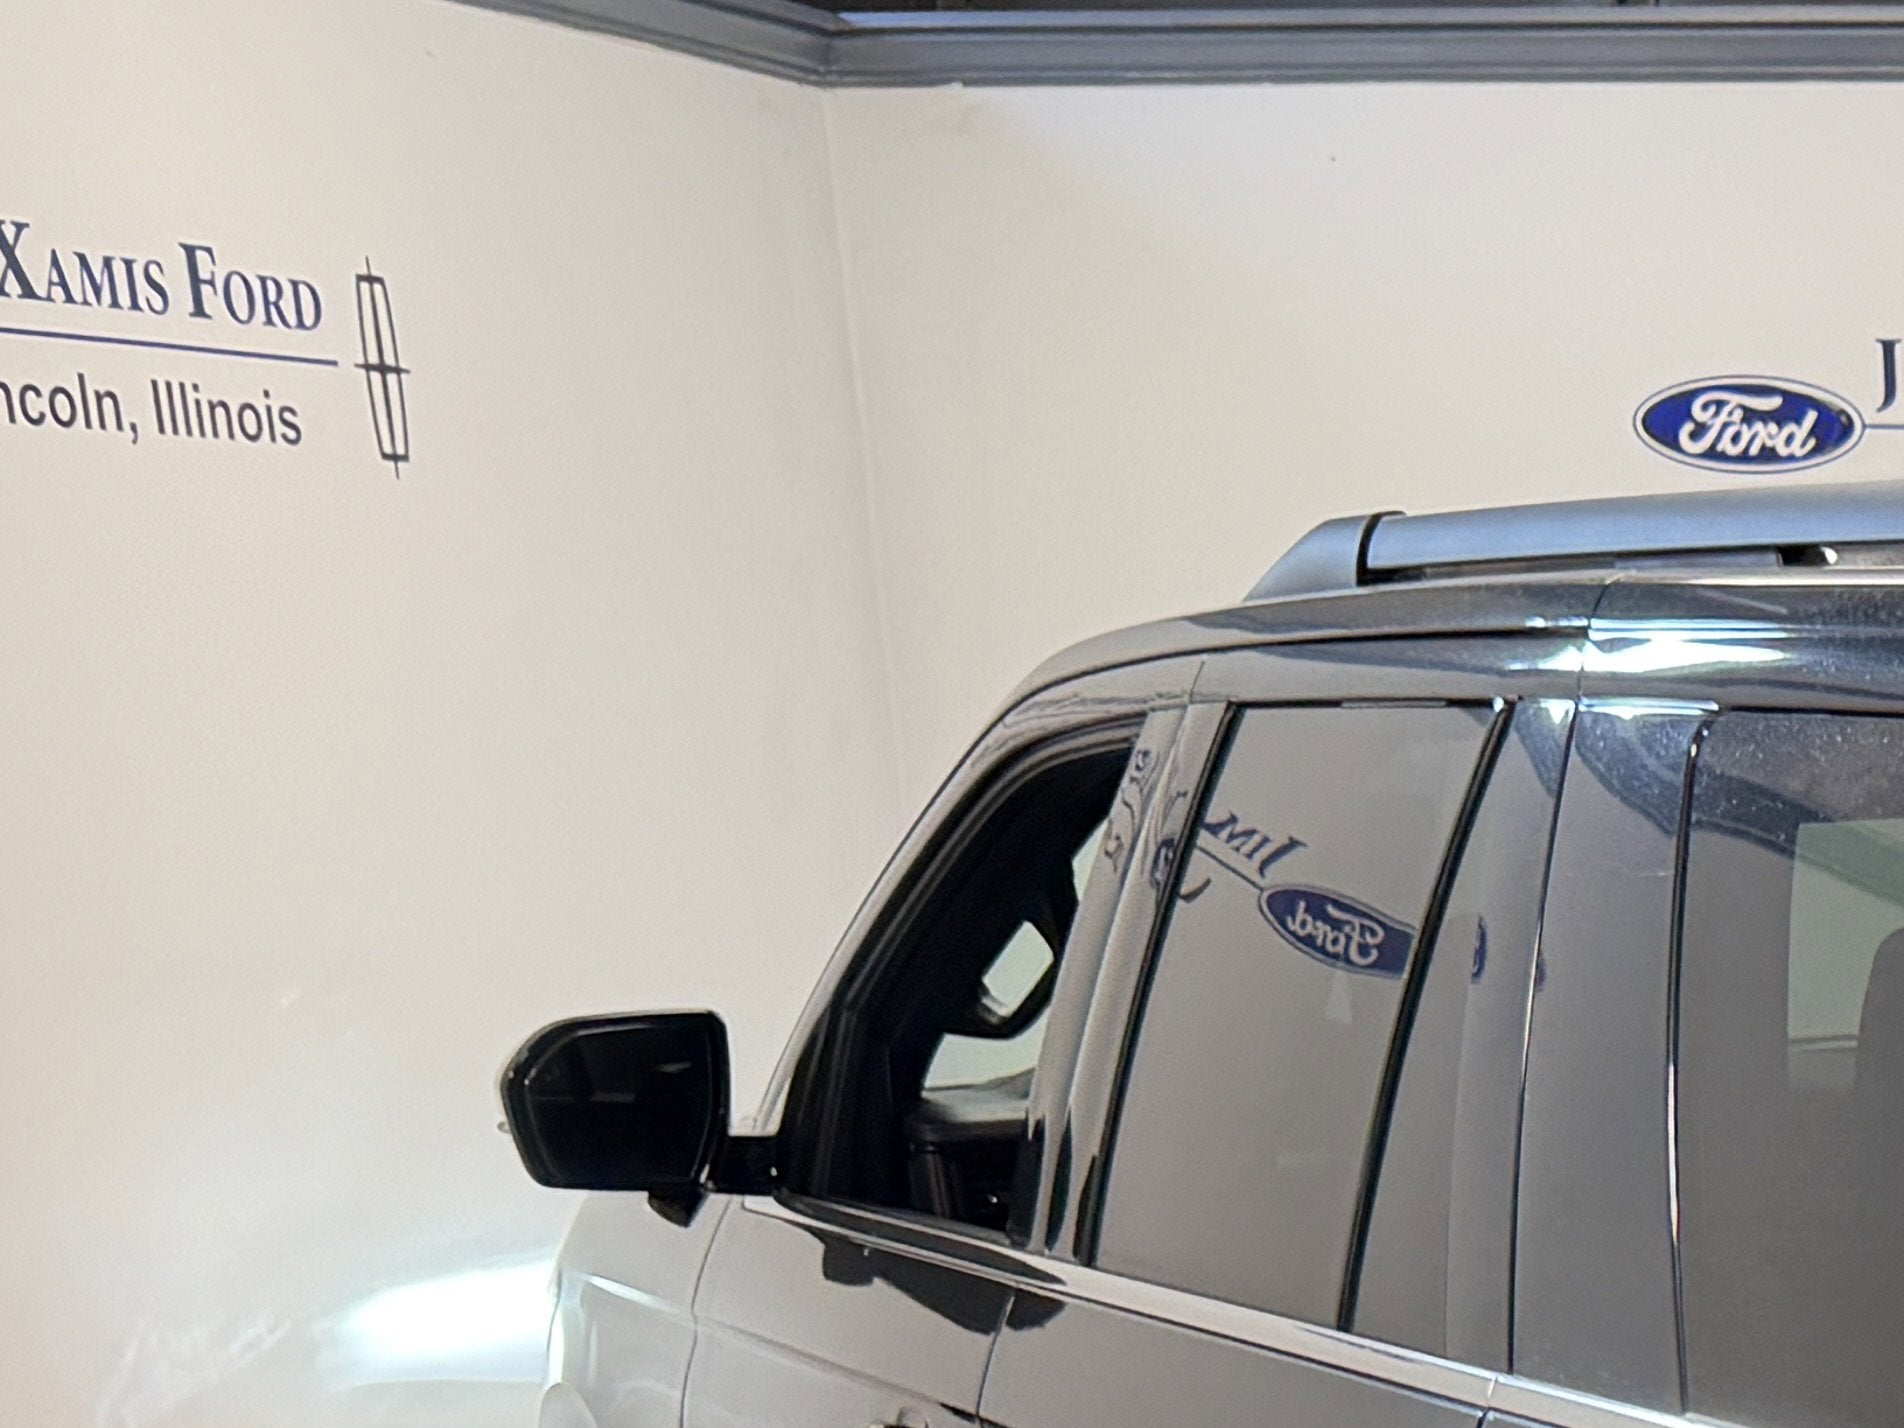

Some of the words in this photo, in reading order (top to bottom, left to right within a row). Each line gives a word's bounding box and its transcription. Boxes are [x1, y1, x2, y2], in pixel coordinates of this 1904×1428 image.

[178, 242, 323, 331] FORD
[0, 372, 139, 446] ncoln,
[150, 379, 303, 446] Illinois
[1678, 390, 1819, 458] Ford
